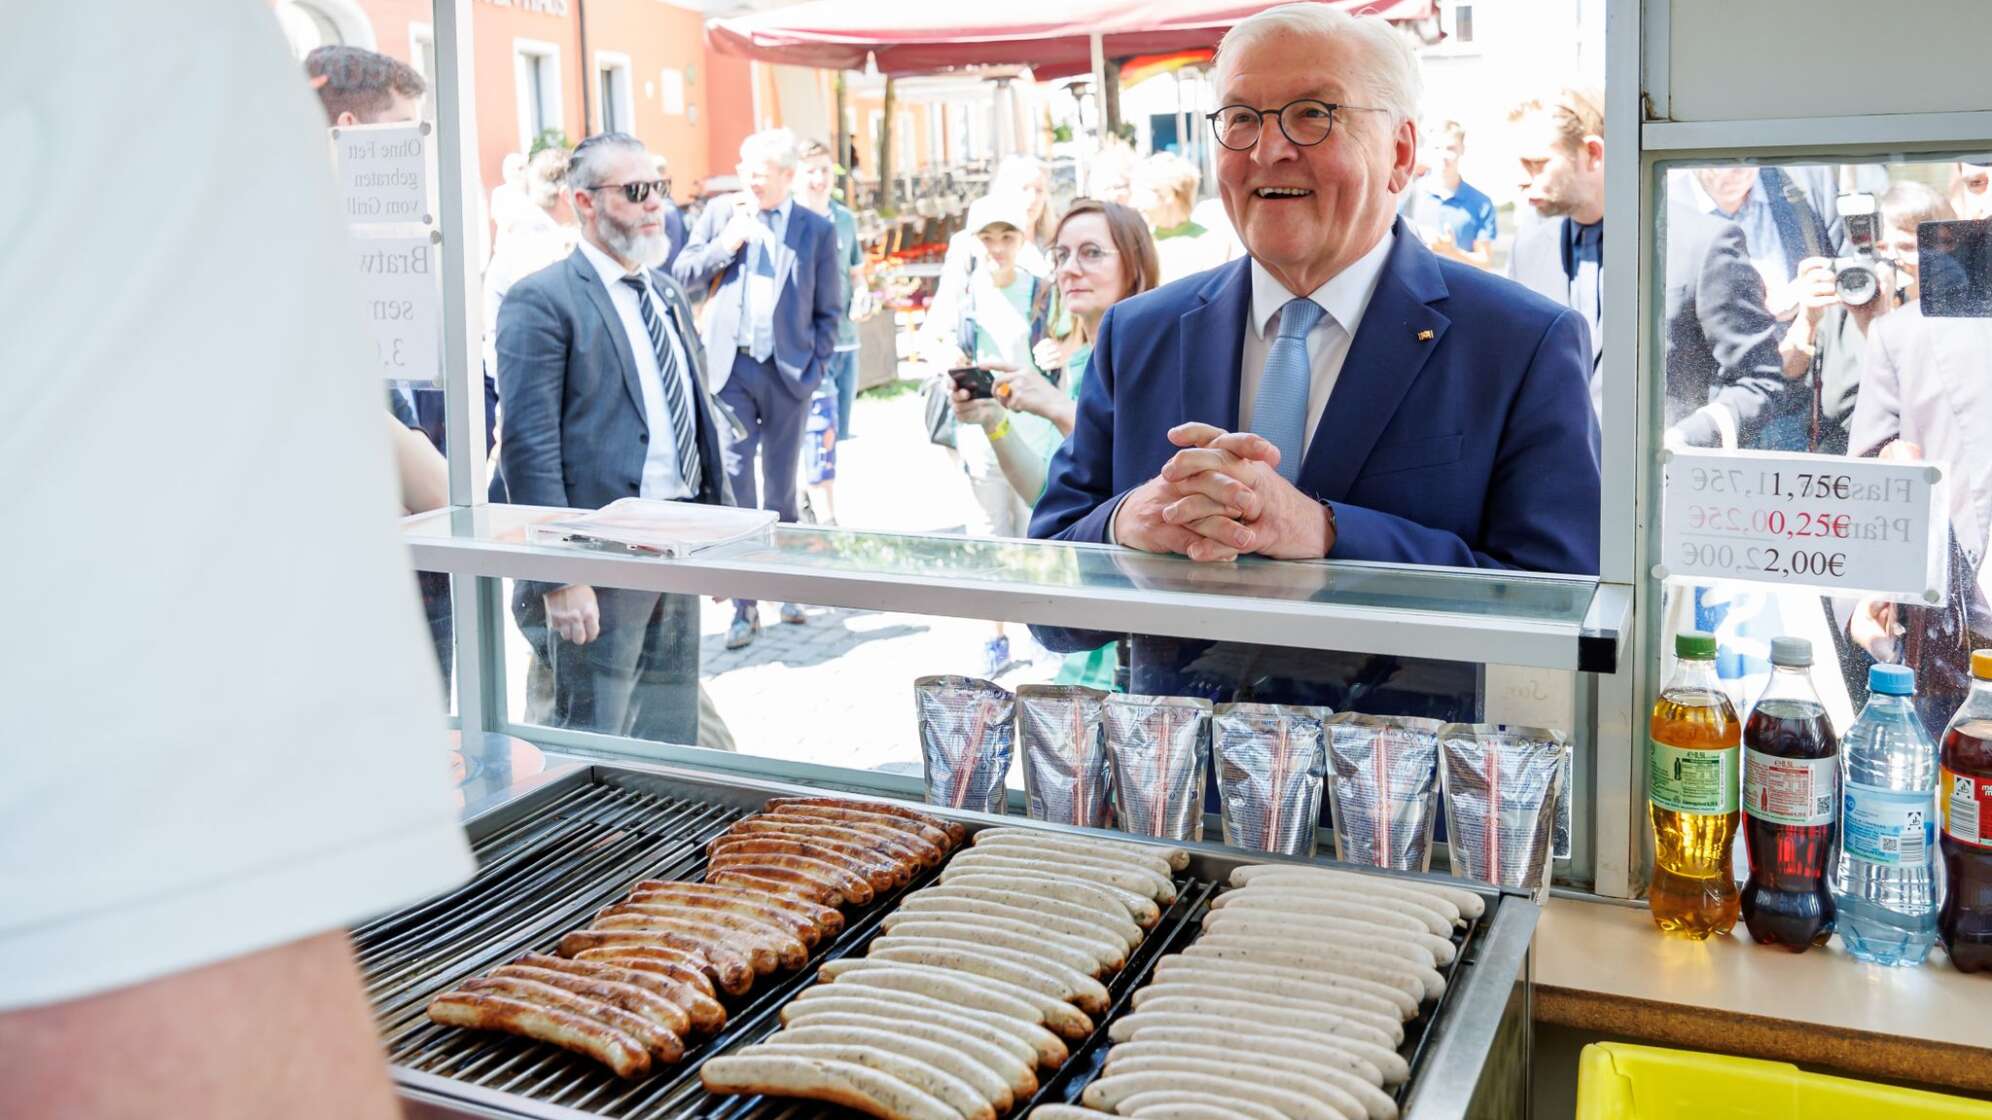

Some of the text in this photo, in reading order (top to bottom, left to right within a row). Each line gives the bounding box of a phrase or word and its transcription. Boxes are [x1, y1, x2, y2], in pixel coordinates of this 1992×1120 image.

[1771, 471, 1852, 501] 1,75€
[1768, 510, 1851, 540] 0,25€
[1763, 547, 1847, 578] 2,00€
